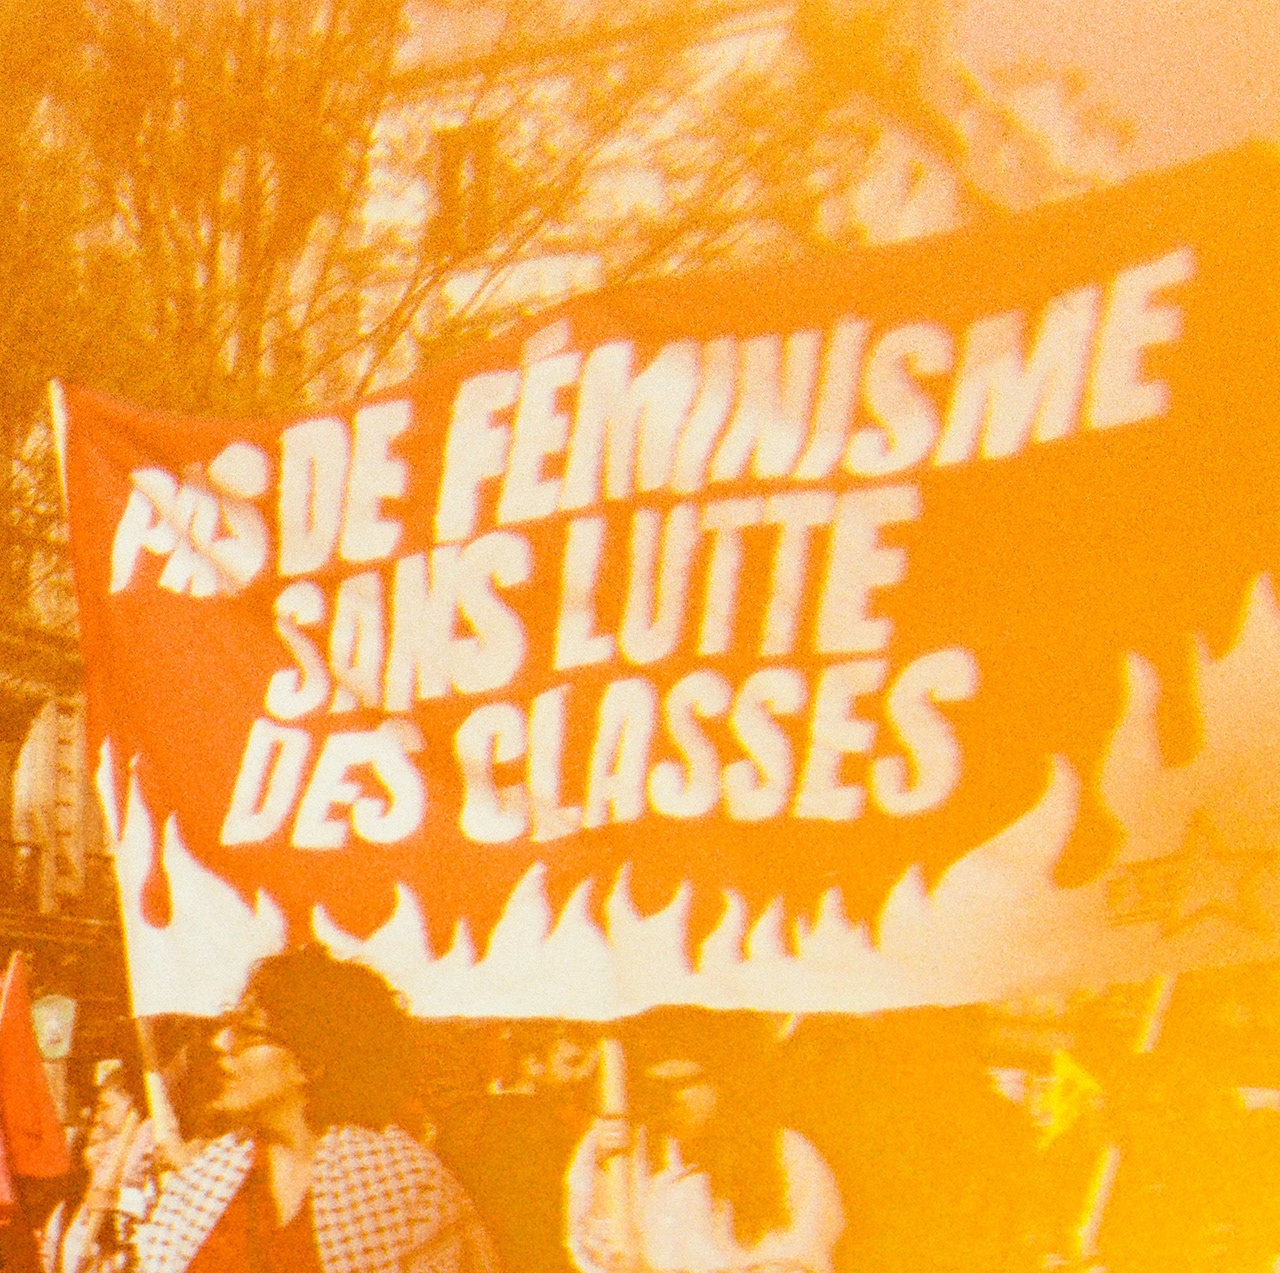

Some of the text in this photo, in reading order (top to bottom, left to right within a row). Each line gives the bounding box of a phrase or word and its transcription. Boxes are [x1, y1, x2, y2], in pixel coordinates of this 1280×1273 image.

[109, 246, 1198, 597] PAS DE FÉMINISME
[264, 484, 924, 721] SANS LUTTE
[219, 647, 979, 850] DES CLASSES
